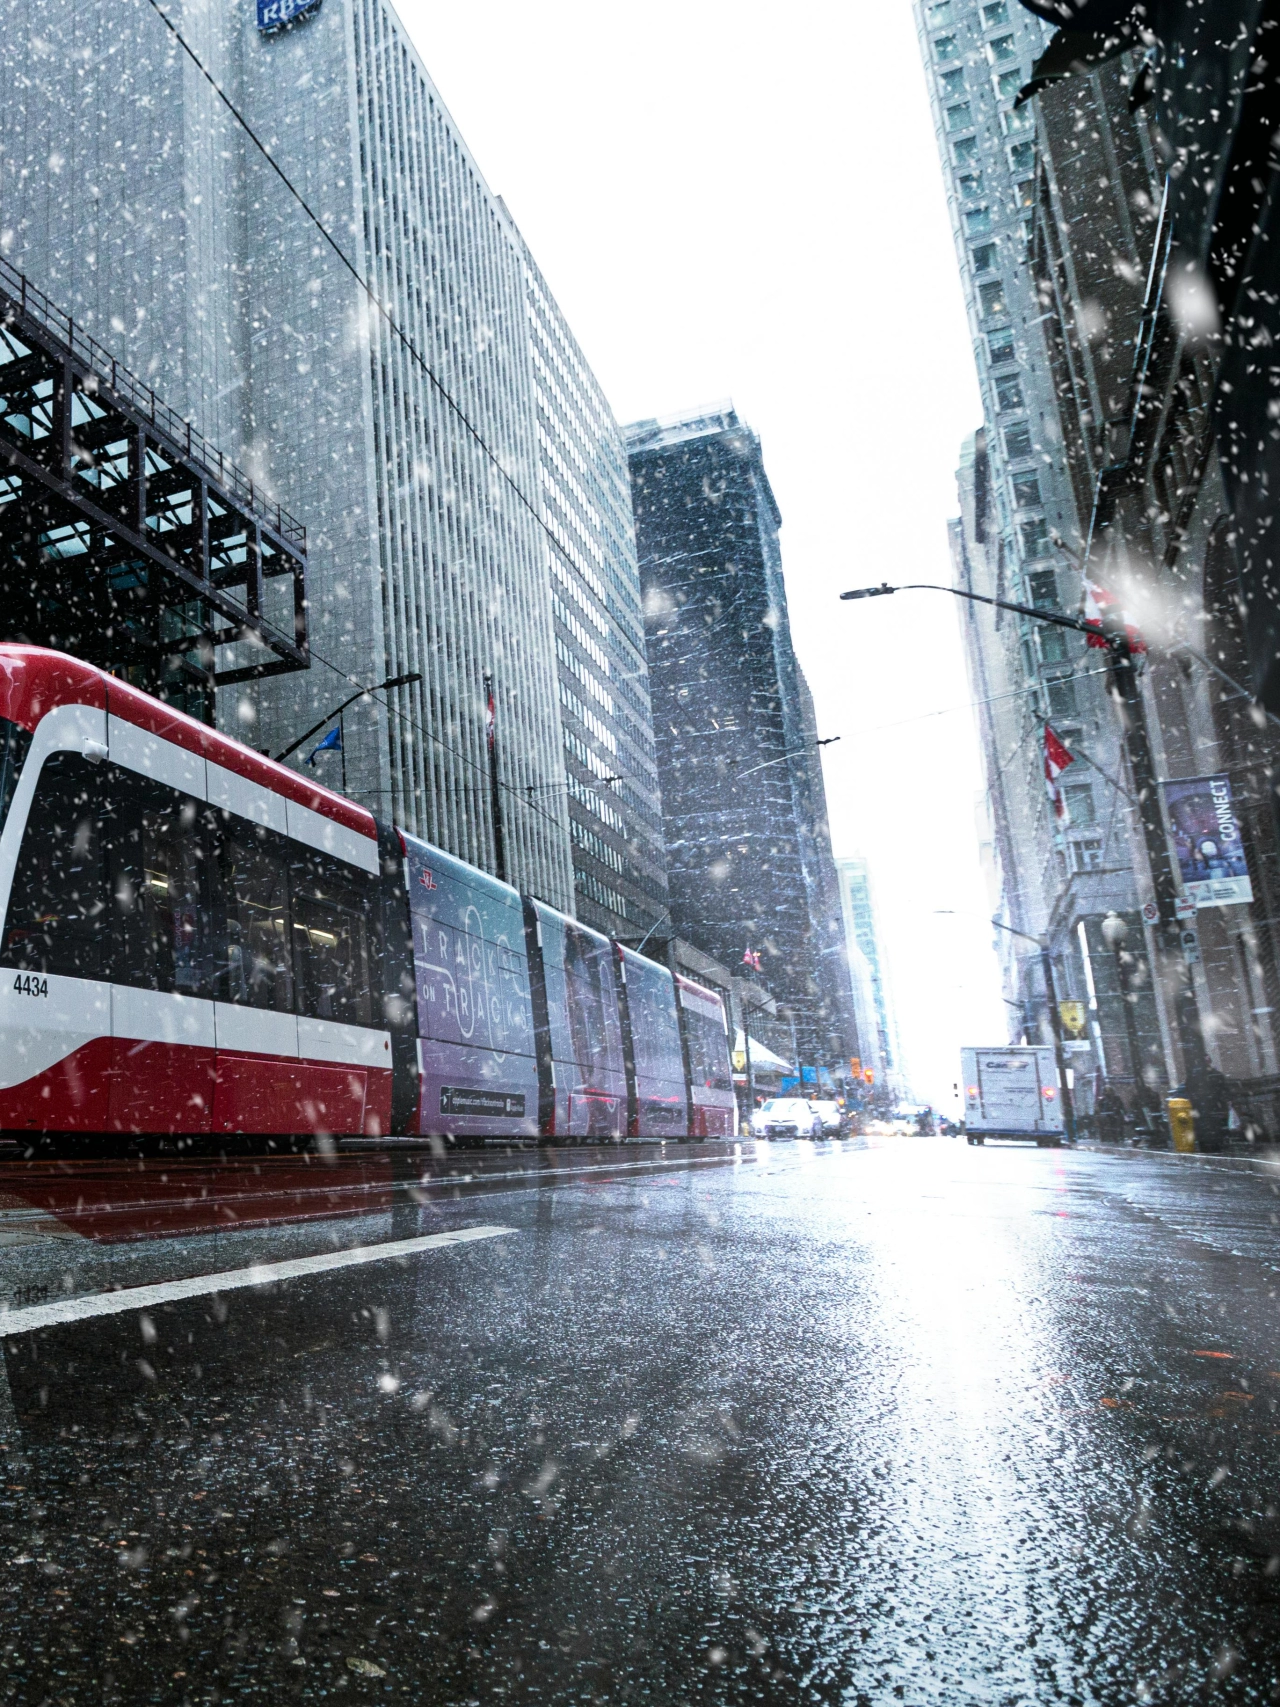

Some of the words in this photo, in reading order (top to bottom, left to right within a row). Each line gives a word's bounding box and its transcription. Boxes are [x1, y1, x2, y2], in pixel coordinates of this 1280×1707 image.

[264, 0, 310, 23] RB
[1209, 780, 1236, 841] CONNECT
[421, 924, 510, 980] TRACKS
[13, 974, 48, 998] 4434
[423, 985, 435, 1001] ON
[443, 983, 527, 1030] TRACKS
